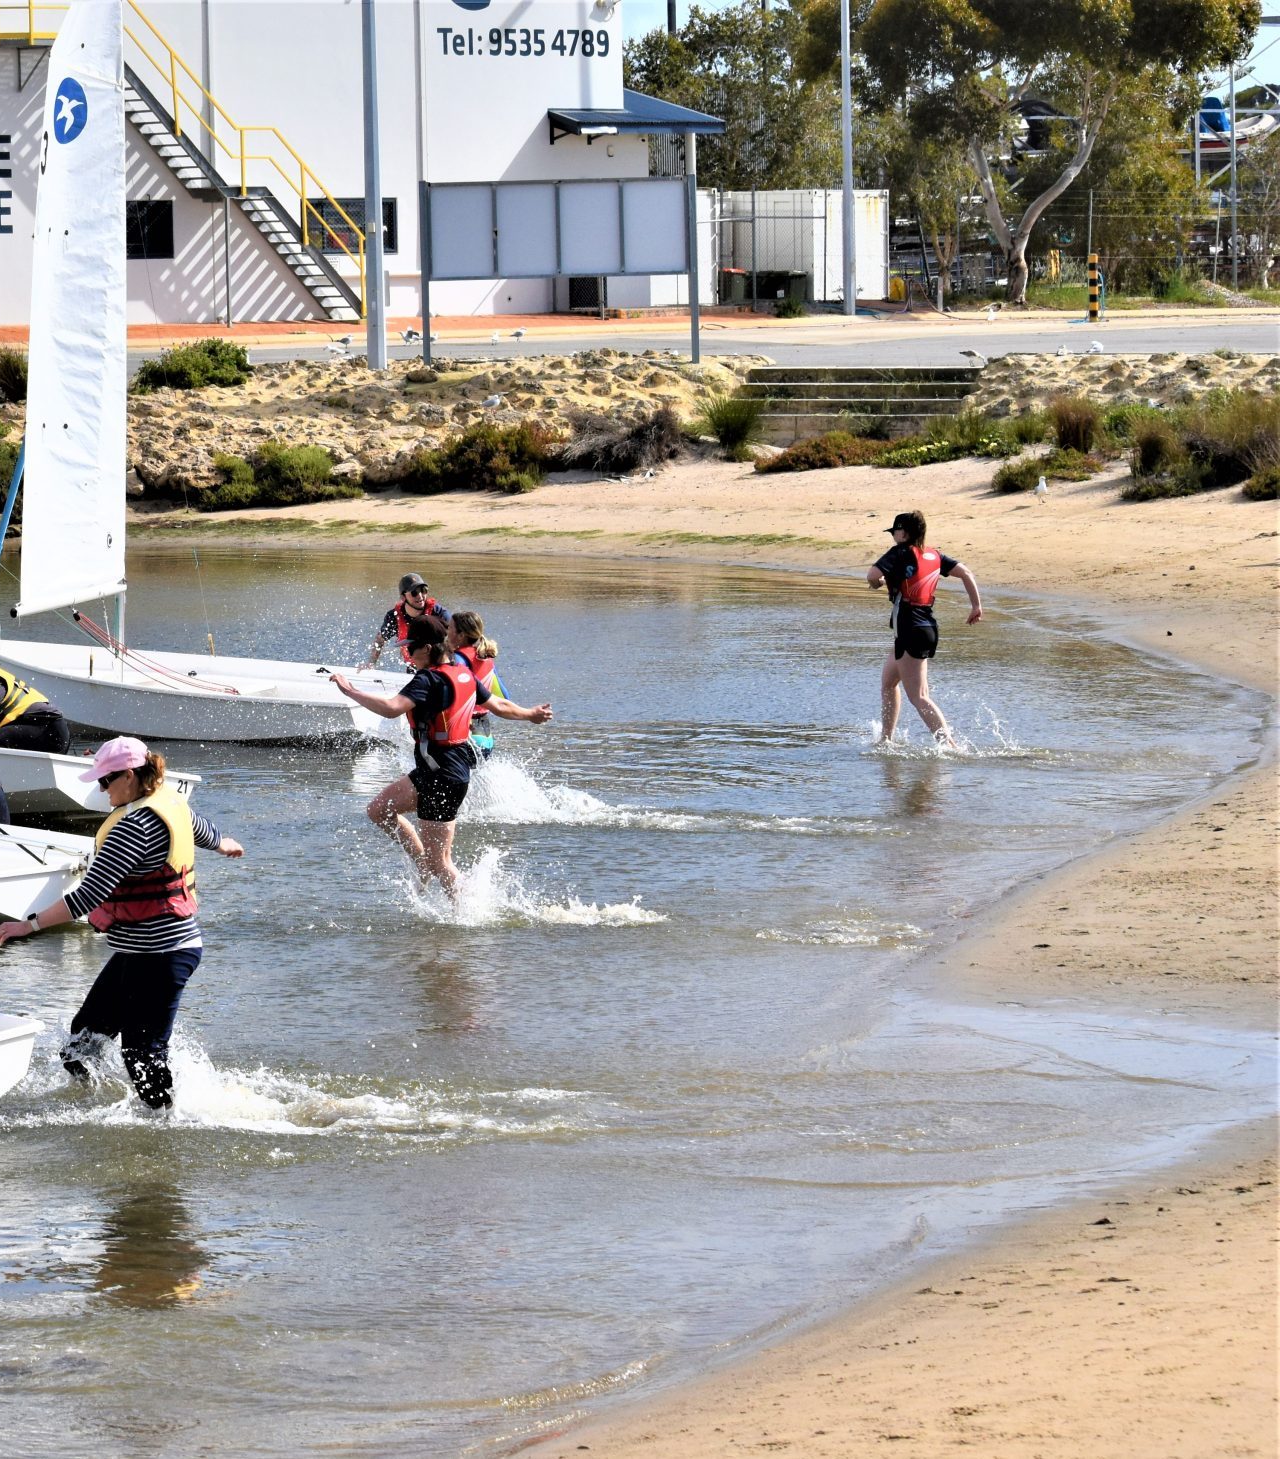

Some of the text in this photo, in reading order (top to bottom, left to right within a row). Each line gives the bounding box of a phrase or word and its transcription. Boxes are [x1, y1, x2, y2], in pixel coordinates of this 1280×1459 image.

[437, 28, 610, 58] Tel: 9535 4789
[176, 779, 189, 794] 21
